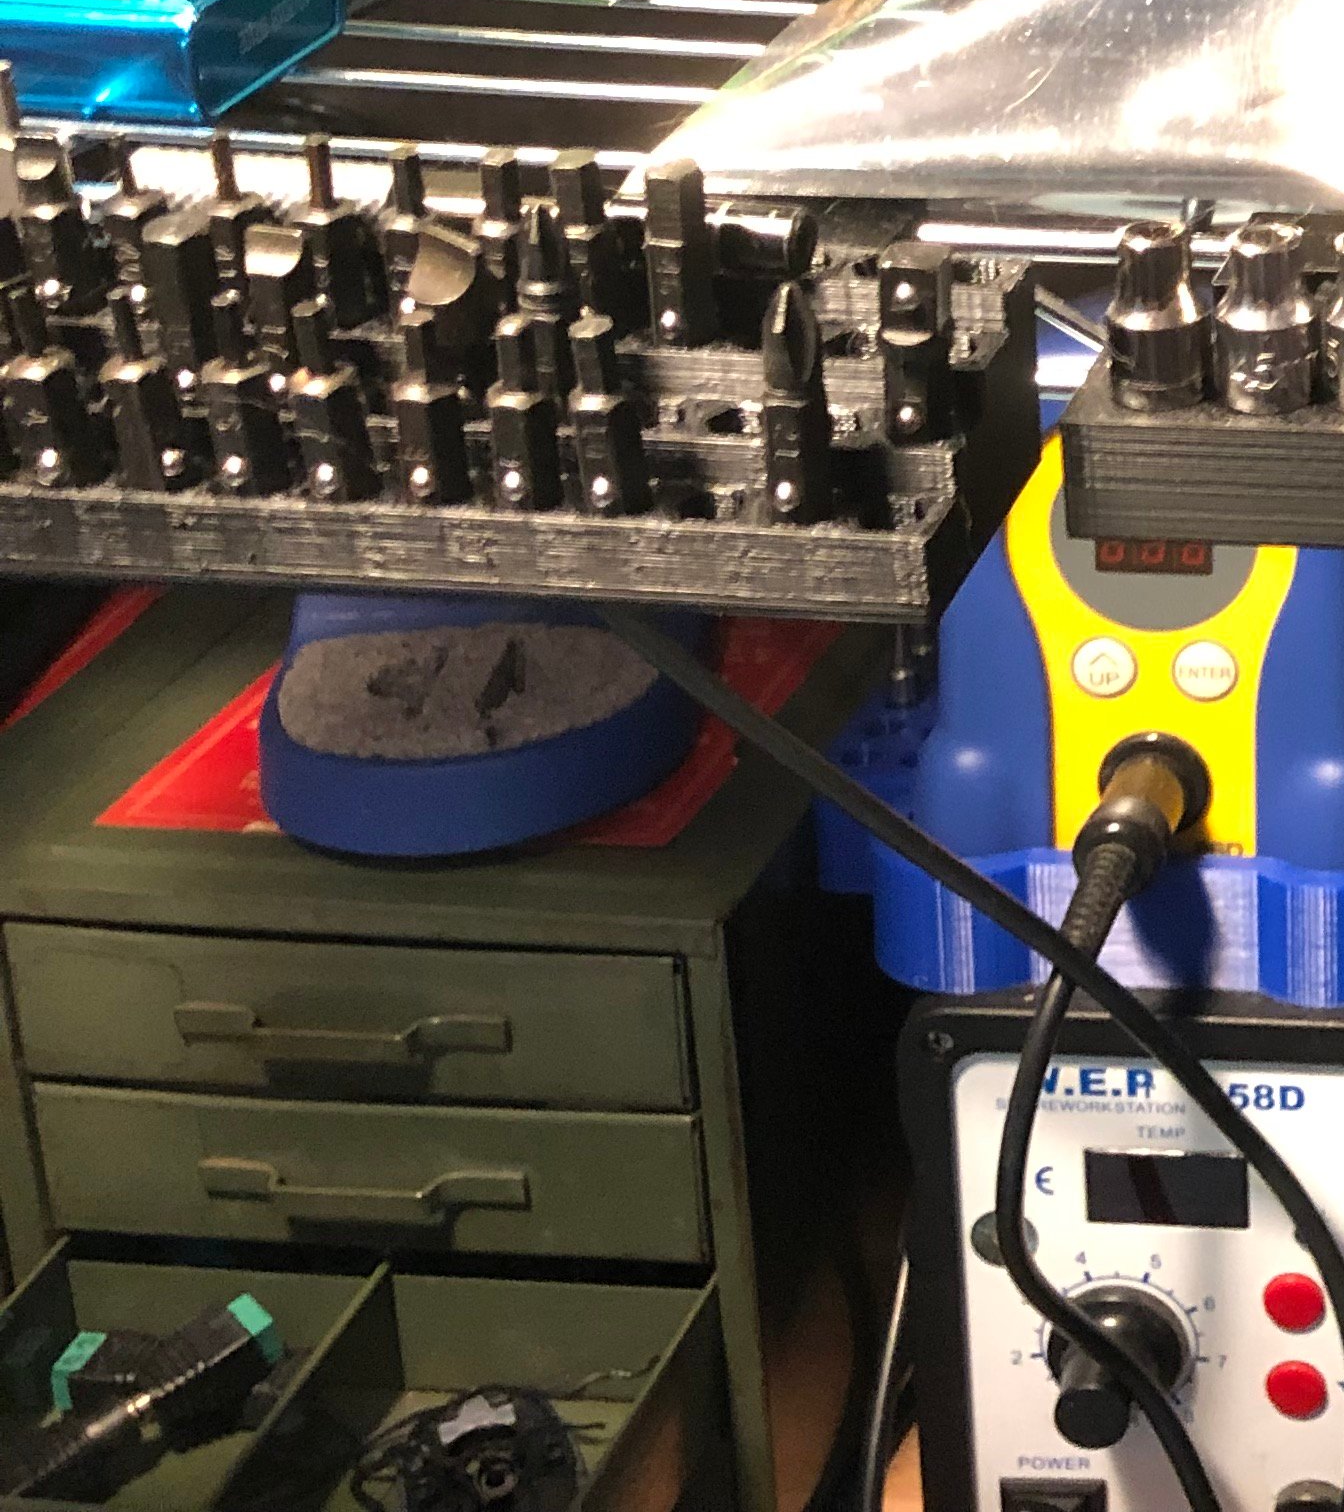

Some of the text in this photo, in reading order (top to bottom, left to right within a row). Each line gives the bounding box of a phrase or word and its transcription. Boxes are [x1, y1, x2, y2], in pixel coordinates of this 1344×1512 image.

[1089, 672, 1120, 686] UP
[1179, 666, 1232, 679] ENTER
[1227, 1083, 1306, 1112] 58D
[1136, 1125, 1186, 1139] TEMP
[1075, 1251, 1087, 1266] 4
[1150, 1254, 1162, 1269] 5
[1017, 1456, 1091, 1471] POWER
